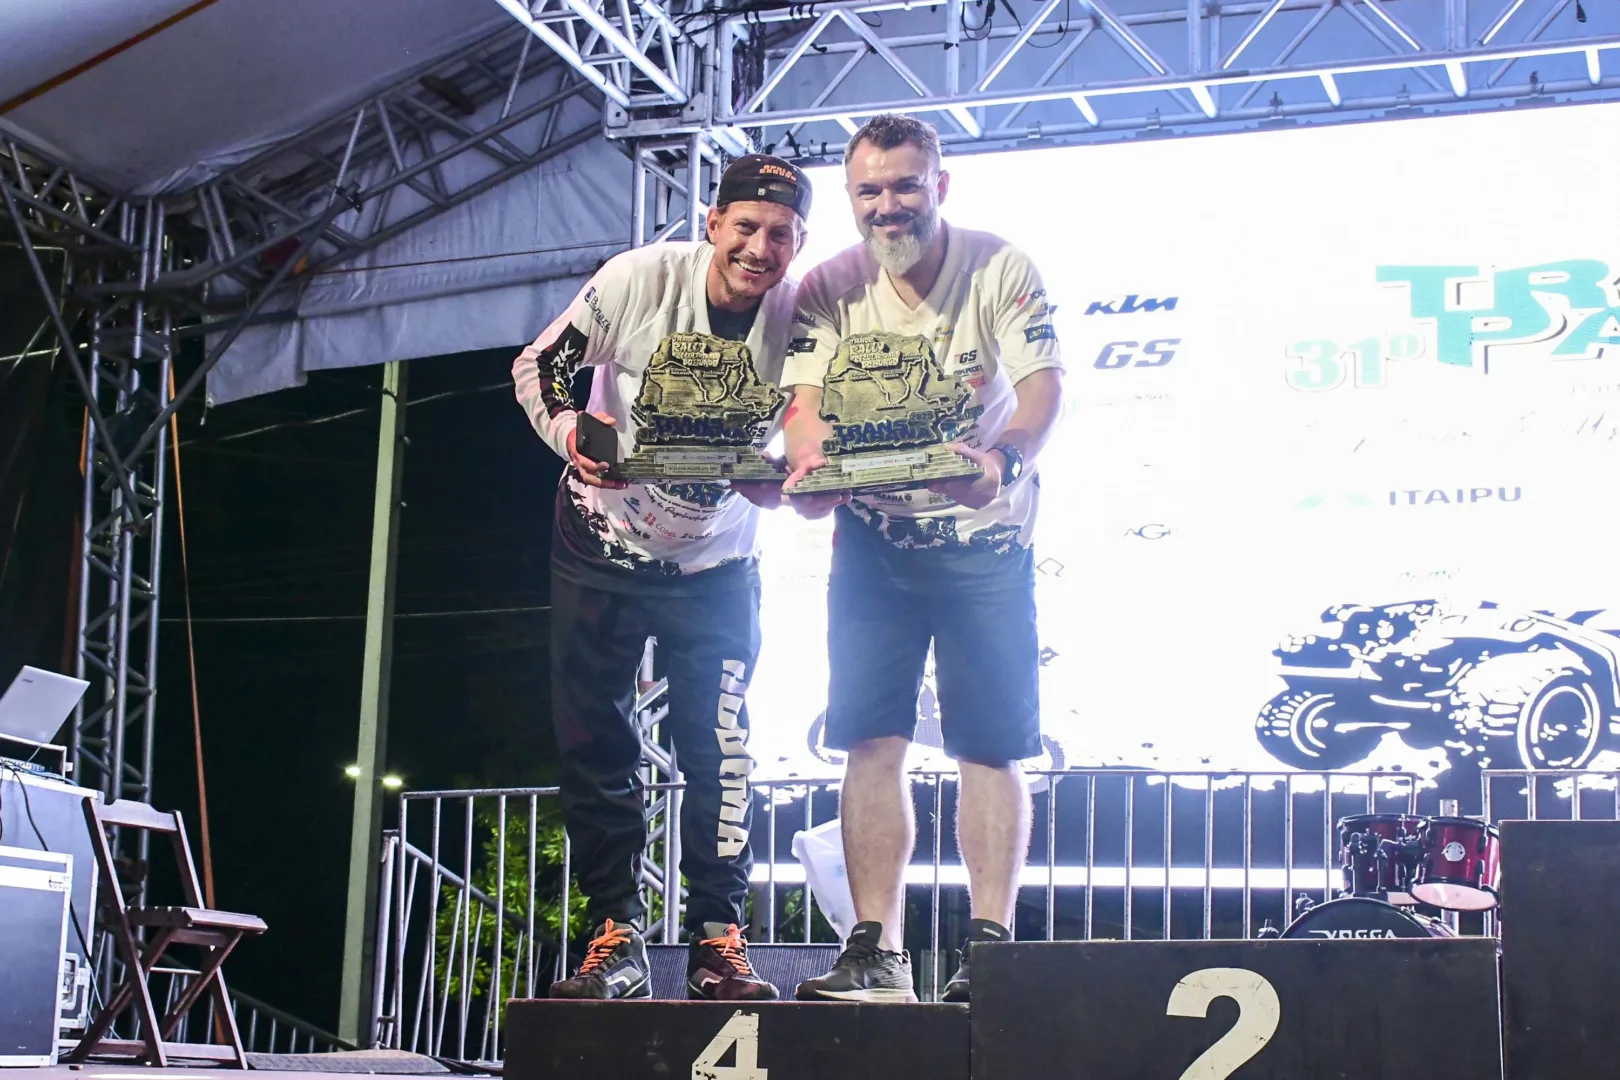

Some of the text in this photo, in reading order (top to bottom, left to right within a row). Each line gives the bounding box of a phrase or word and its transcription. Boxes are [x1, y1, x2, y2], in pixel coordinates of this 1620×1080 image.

[849, 342, 884, 356] RALLY
[1093, 338, 1182, 369] GS
[1390, 486, 1522, 506] ITAIPU
[1166, 968, 1280, 1080] 2
[691, 1009, 768, 1080] 4
